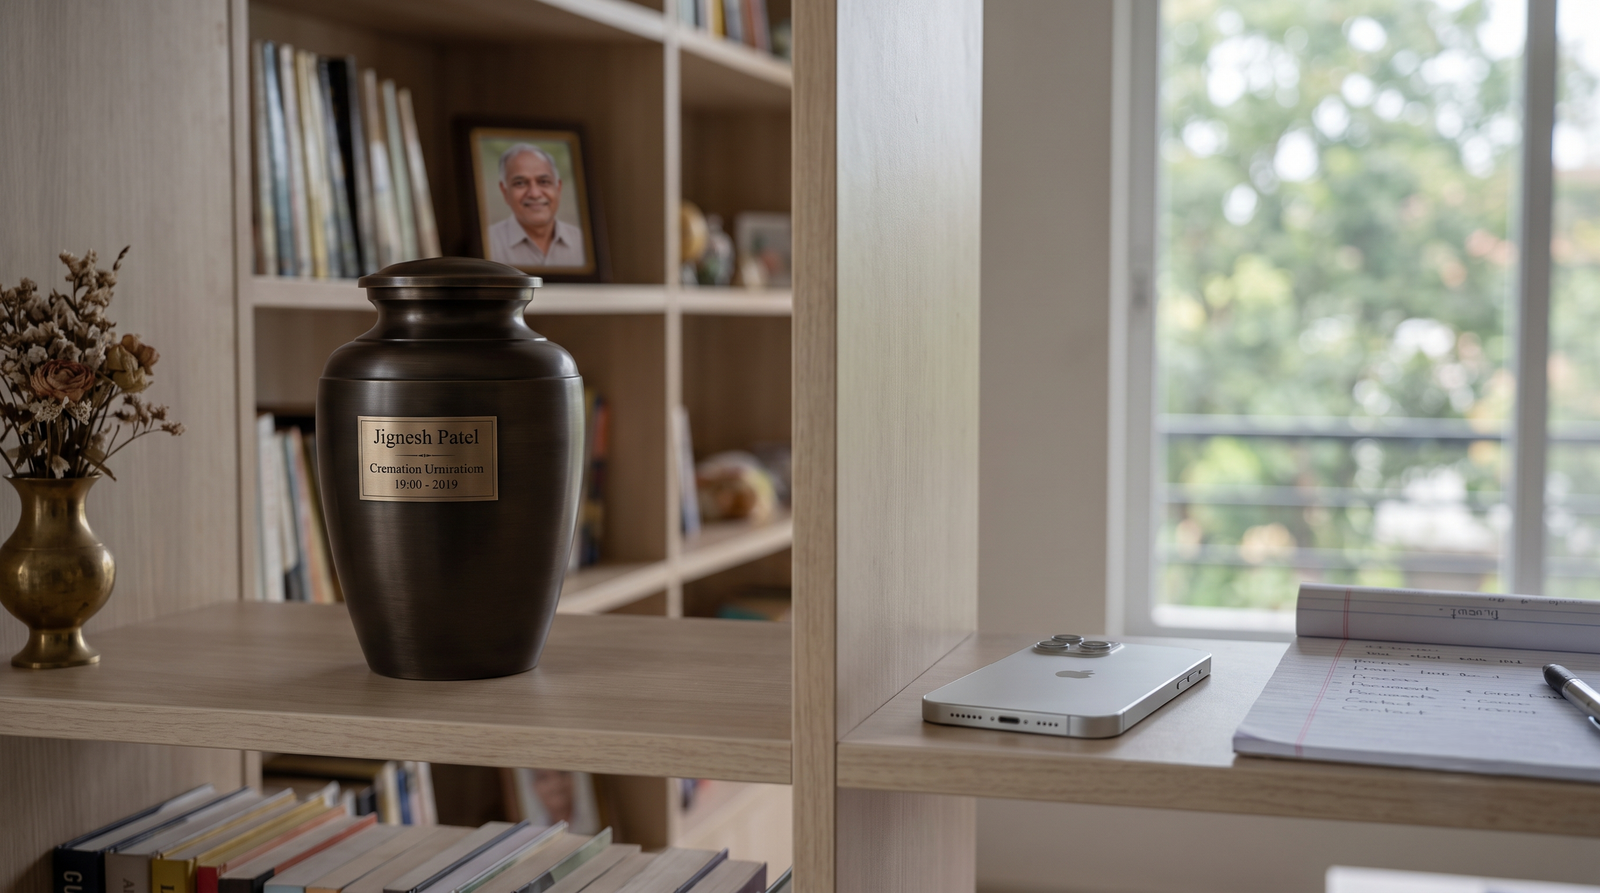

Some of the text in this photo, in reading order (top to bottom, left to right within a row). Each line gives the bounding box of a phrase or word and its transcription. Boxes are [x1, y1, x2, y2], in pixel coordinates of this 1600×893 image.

[373, 428, 479, 449] Jignesh Patel
[369, 462, 422, 474] Cremation
[395, 479, 422, 490] 19:00
[432, 479, 458, 490] 2019
